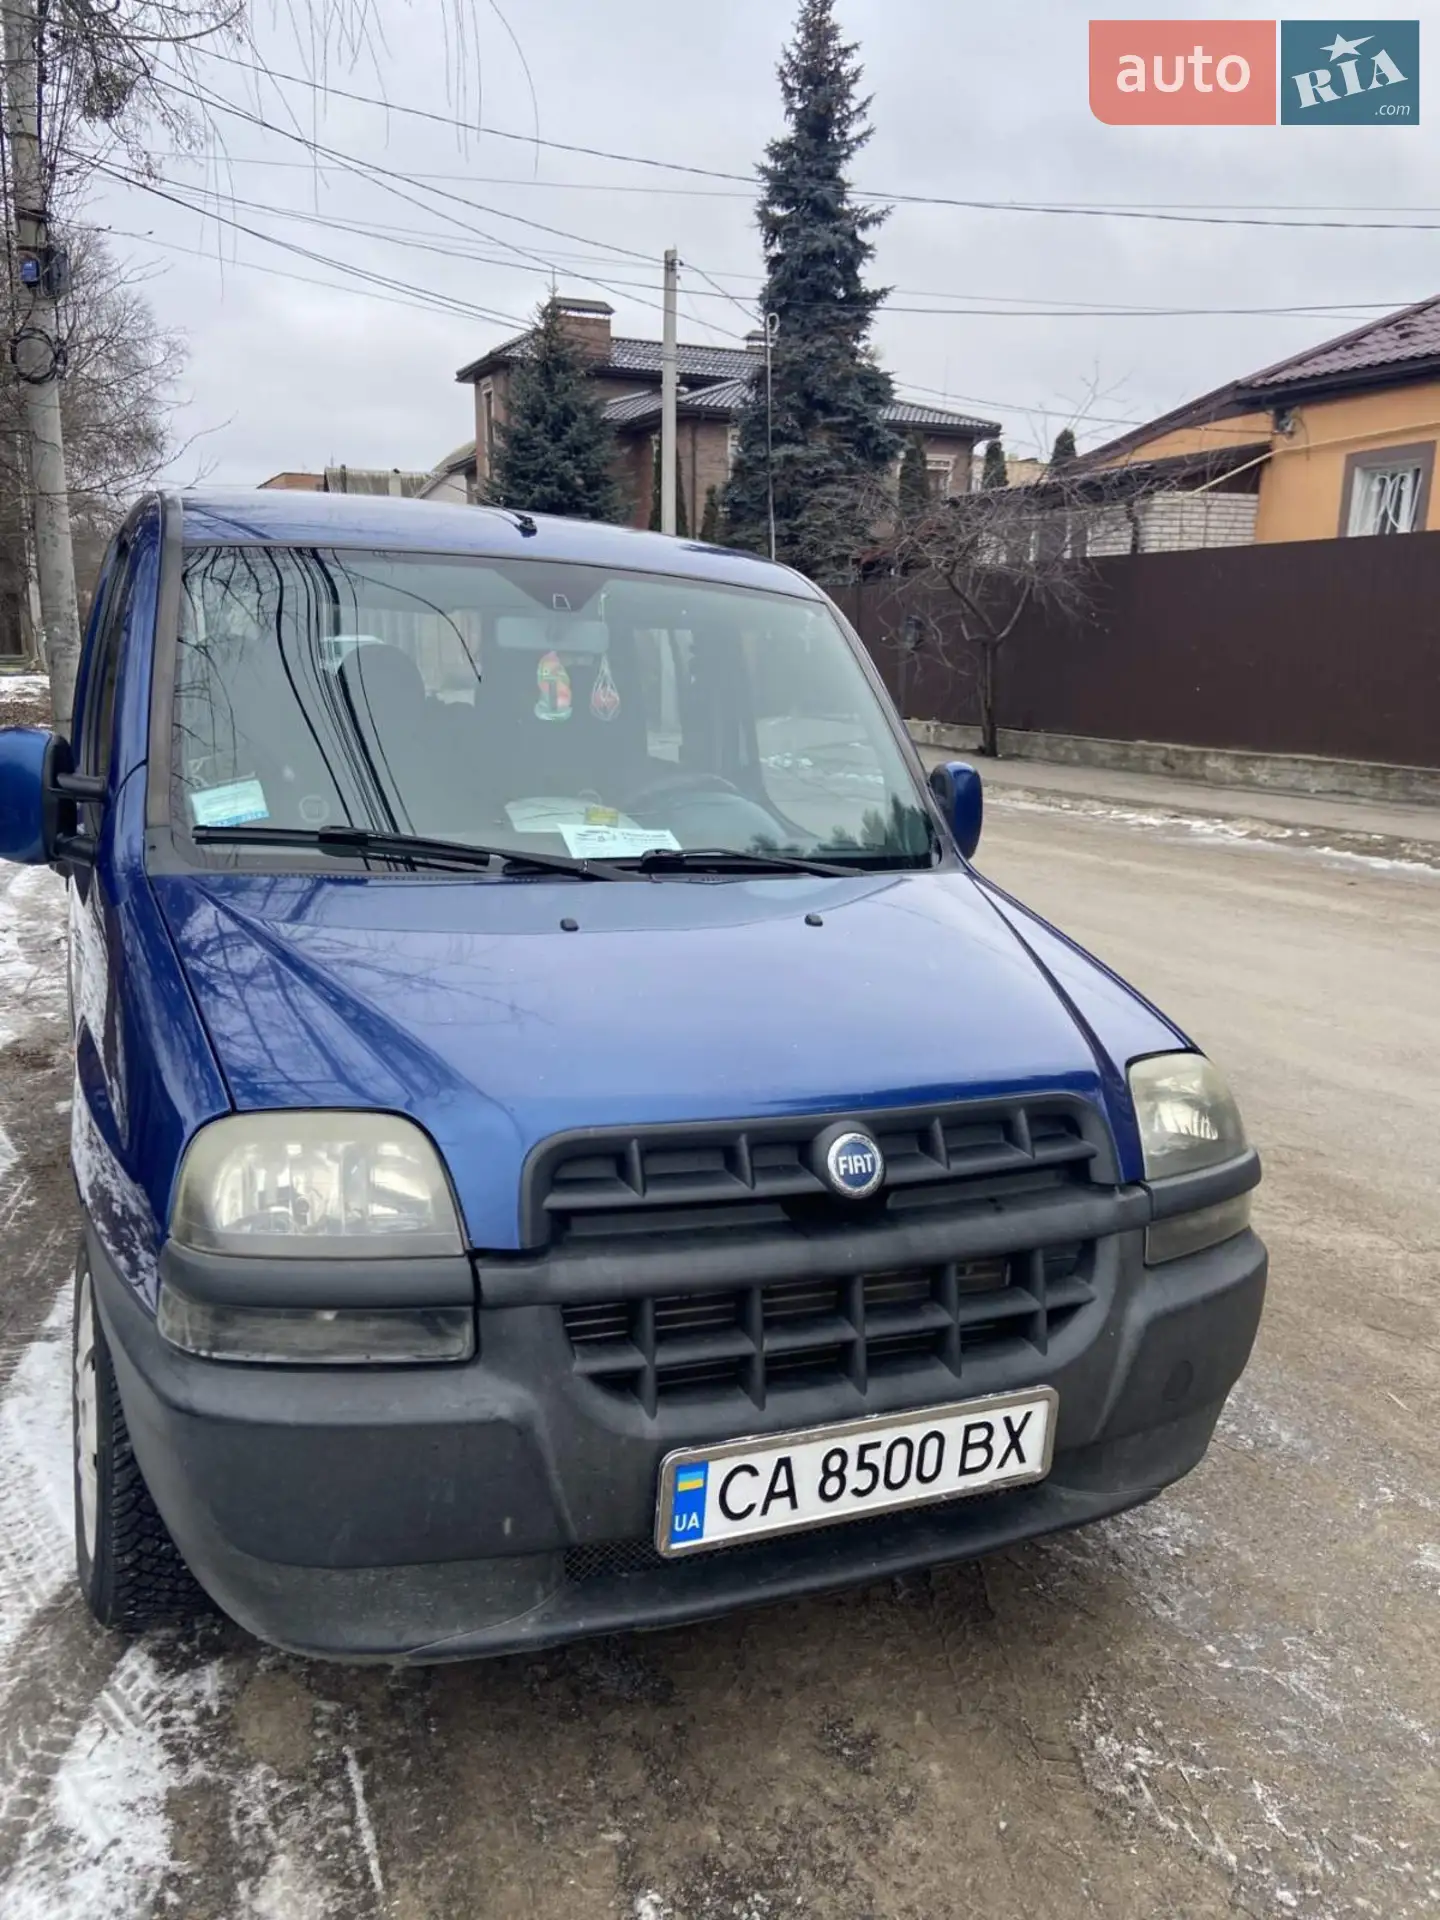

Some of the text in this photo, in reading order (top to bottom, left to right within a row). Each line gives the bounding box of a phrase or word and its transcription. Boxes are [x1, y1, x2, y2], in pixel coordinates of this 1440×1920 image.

[838, 1154, 873, 1176] FIAT
[718, 1411, 1033, 1521] CA 8500 BX
[674, 1513, 700, 1532] UA
